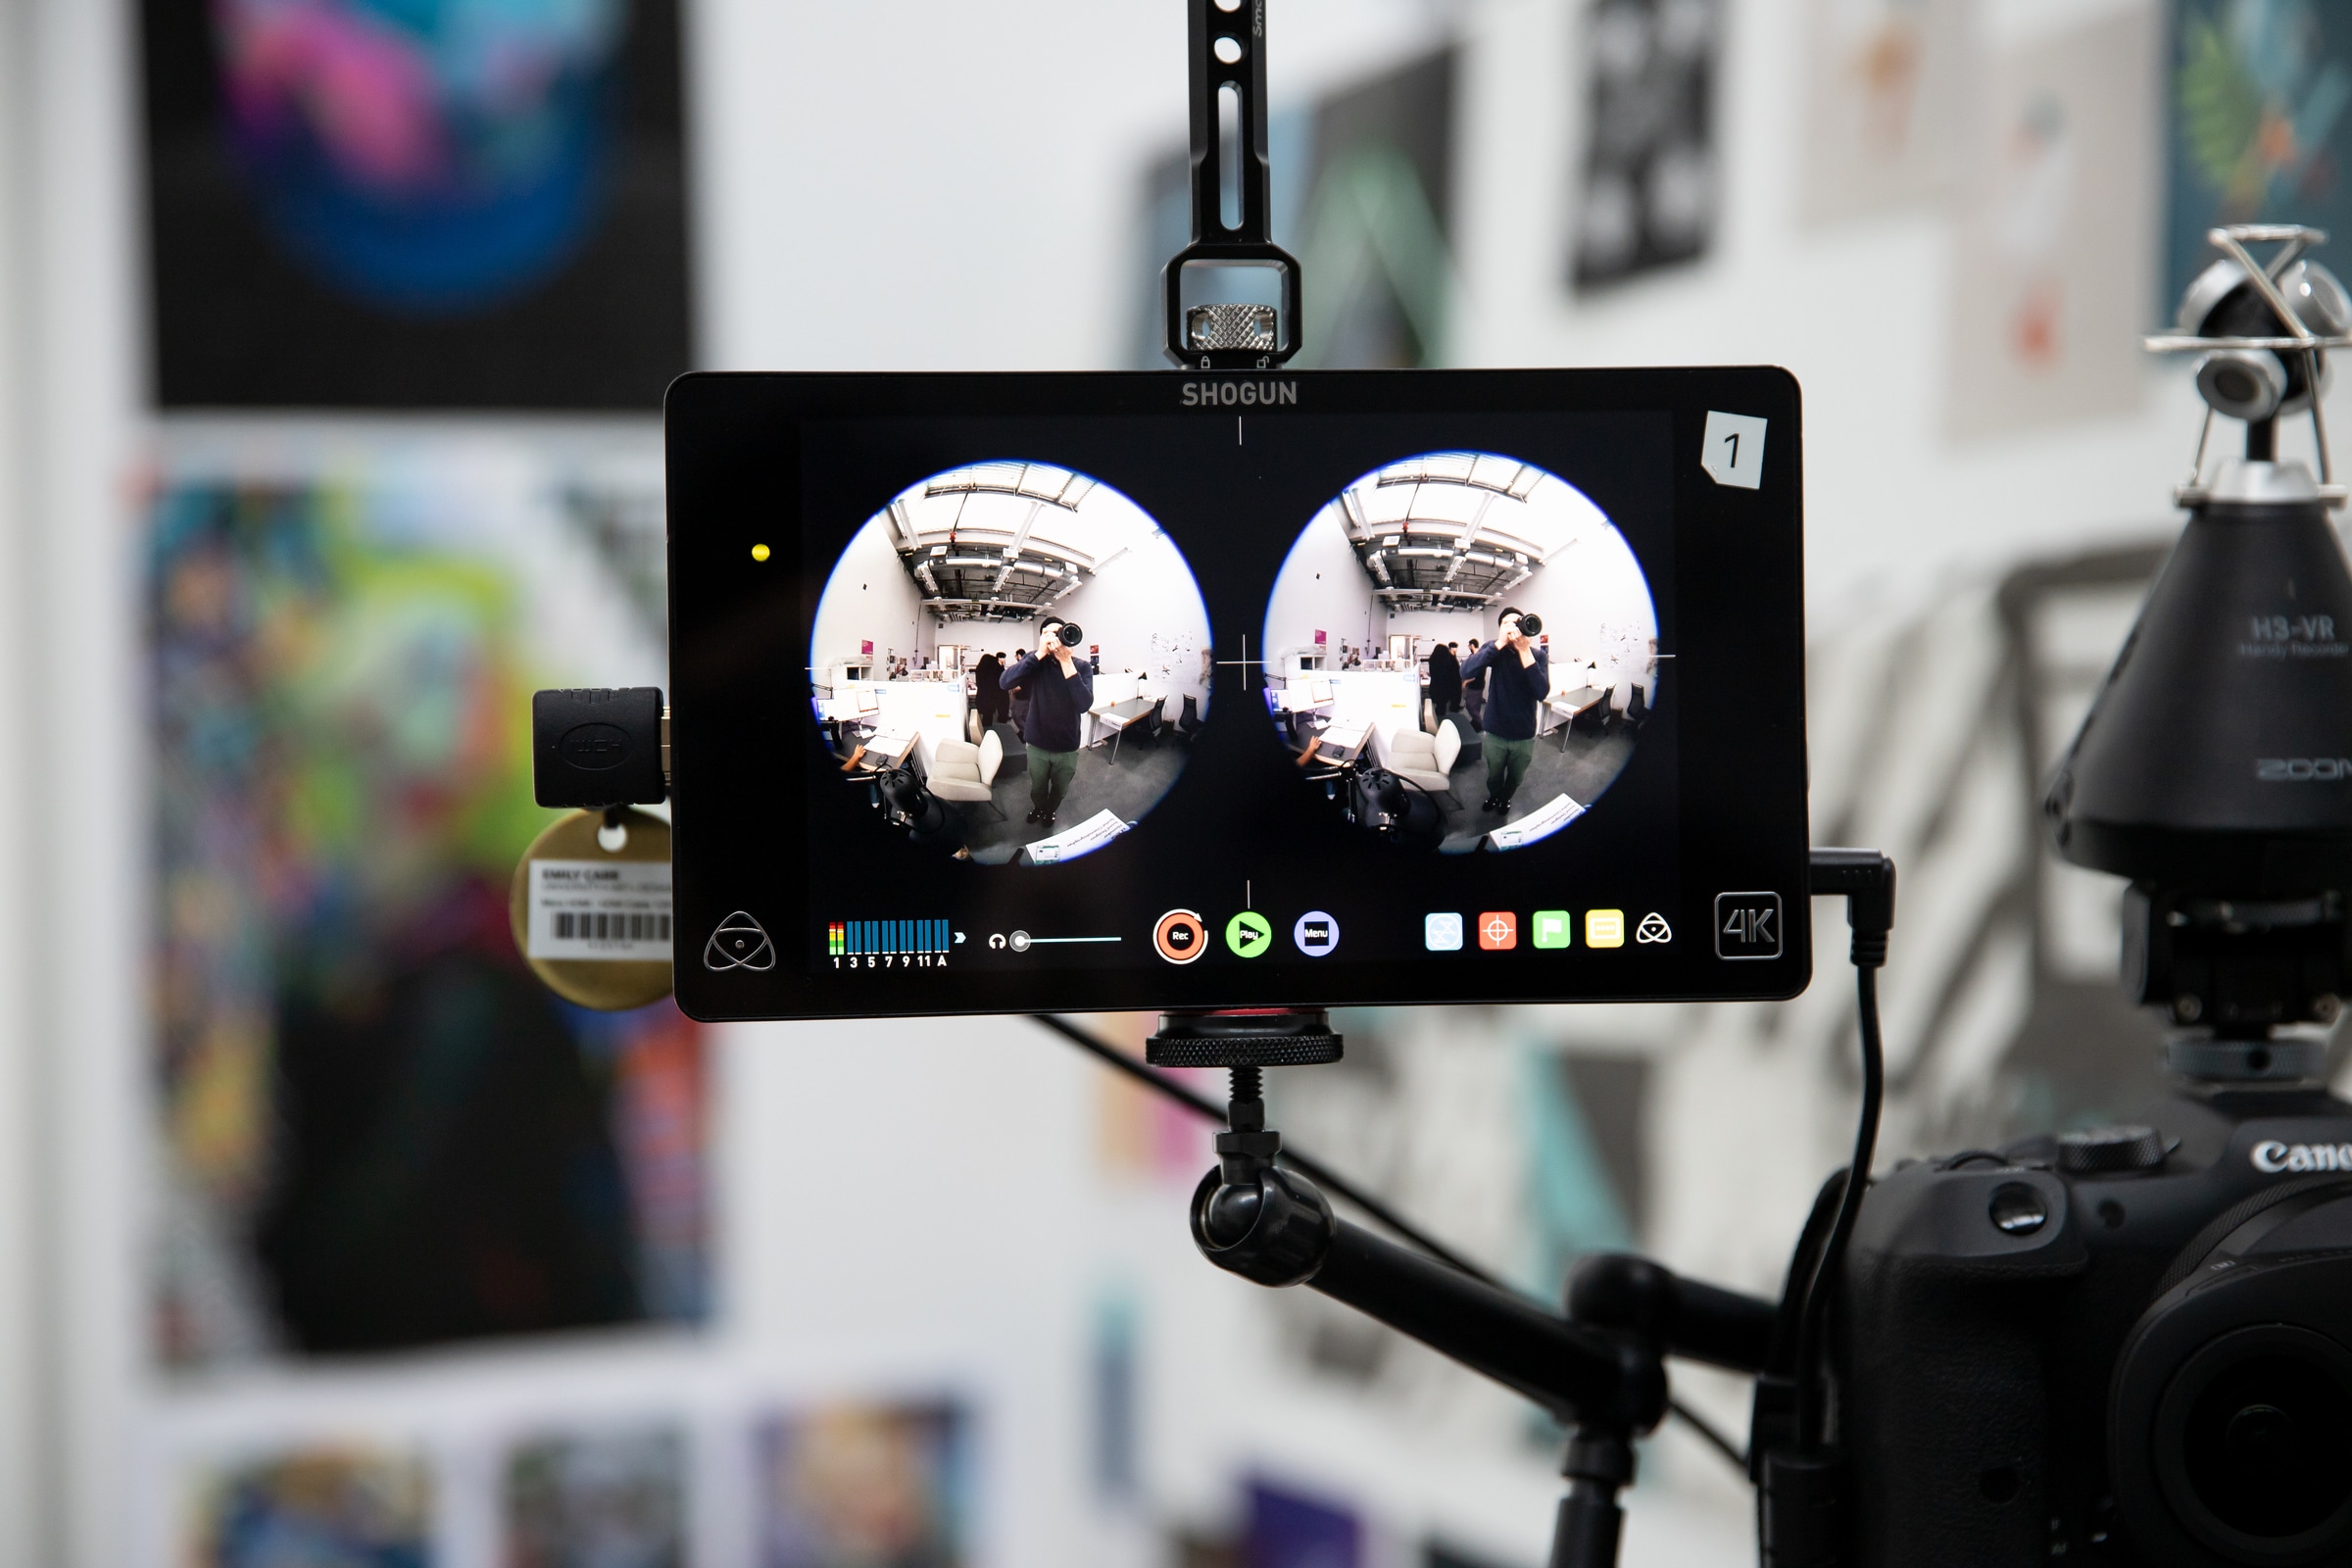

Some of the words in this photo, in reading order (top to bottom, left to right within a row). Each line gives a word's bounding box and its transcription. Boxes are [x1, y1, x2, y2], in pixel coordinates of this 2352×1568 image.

[1182, 381, 1298, 406] SHOGUN
[1724, 432, 1740, 468] 1
[2253, 614, 2335, 640] H3-VR
[1304, 928, 1329, 938] Menu
[1722, 908, 1776, 943] 4K
[1172, 931, 1190, 941] Rec
[1239, 930, 1259, 941] Play
[833, 956, 840, 969] 1
[850, 956, 858, 968] 3
[867, 956, 876, 968] 5
[885, 956, 894, 968] 7
[902, 956, 910, 967] 9
[917, 955, 931, 967] 11
[937, 955, 948, 967] A
